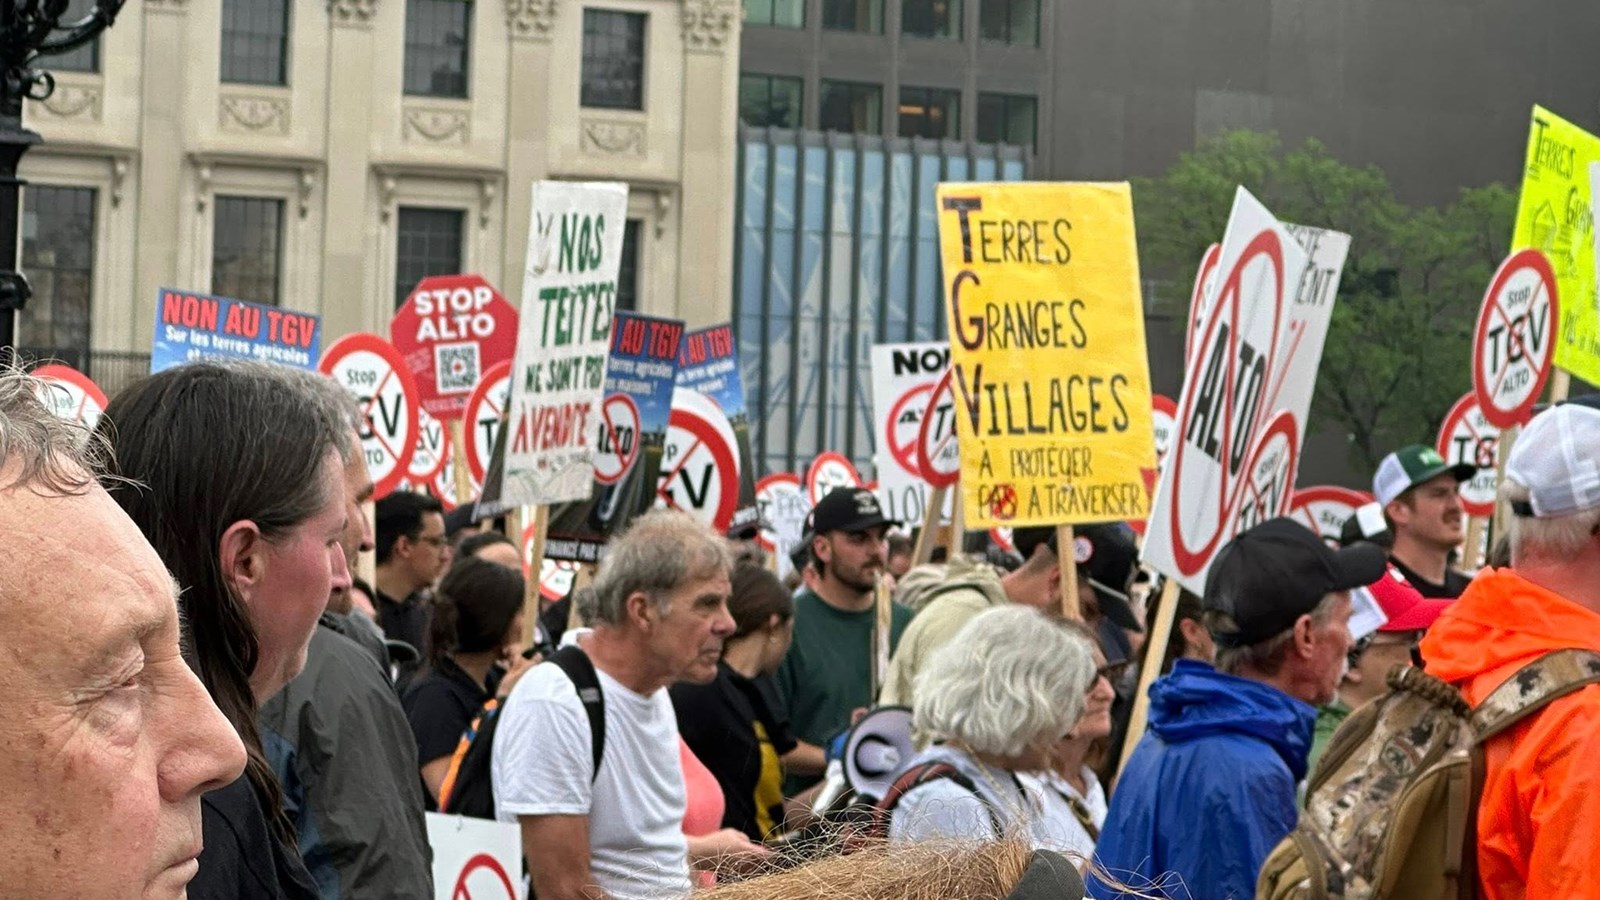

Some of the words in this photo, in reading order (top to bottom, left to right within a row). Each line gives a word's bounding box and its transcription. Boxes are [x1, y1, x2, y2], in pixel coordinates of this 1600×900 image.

[557, 212, 605, 274] NOS
[942, 196, 1072, 265] TERRES
[161, 291, 219, 332] NON
[224, 302, 261, 339] AU
[267, 309, 316, 348] TGV
[413, 286, 494, 316] STOP
[952, 268, 1088, 352] GRANGES
[1507, 286, 1531, 310] Stop
[165, 324, 187, 343] Sur
[189, 329, 210, 348] les
[212, 334, 250, 355] terres
[252, 343, 310, 366] agricoles
[415, 311, 496, 343] ALTO
[618, 317, 646, 356] AU
[648, 320, 683, 361] TGV
[687, 333, 707, 365] AU
[706, 325, 732, 359] TGV
[1488, 301, 1550, 376] TGV
[346, 367, 377, 387] Stop
[1502, 368, 1530, 397] ALTO
[358, 392, 403, 440] GV
[954, 363, 1130, 438] VILLAGES
[1186, 322, 1267, 477] ALTO
[1454, 436, 1494, 469] TG
